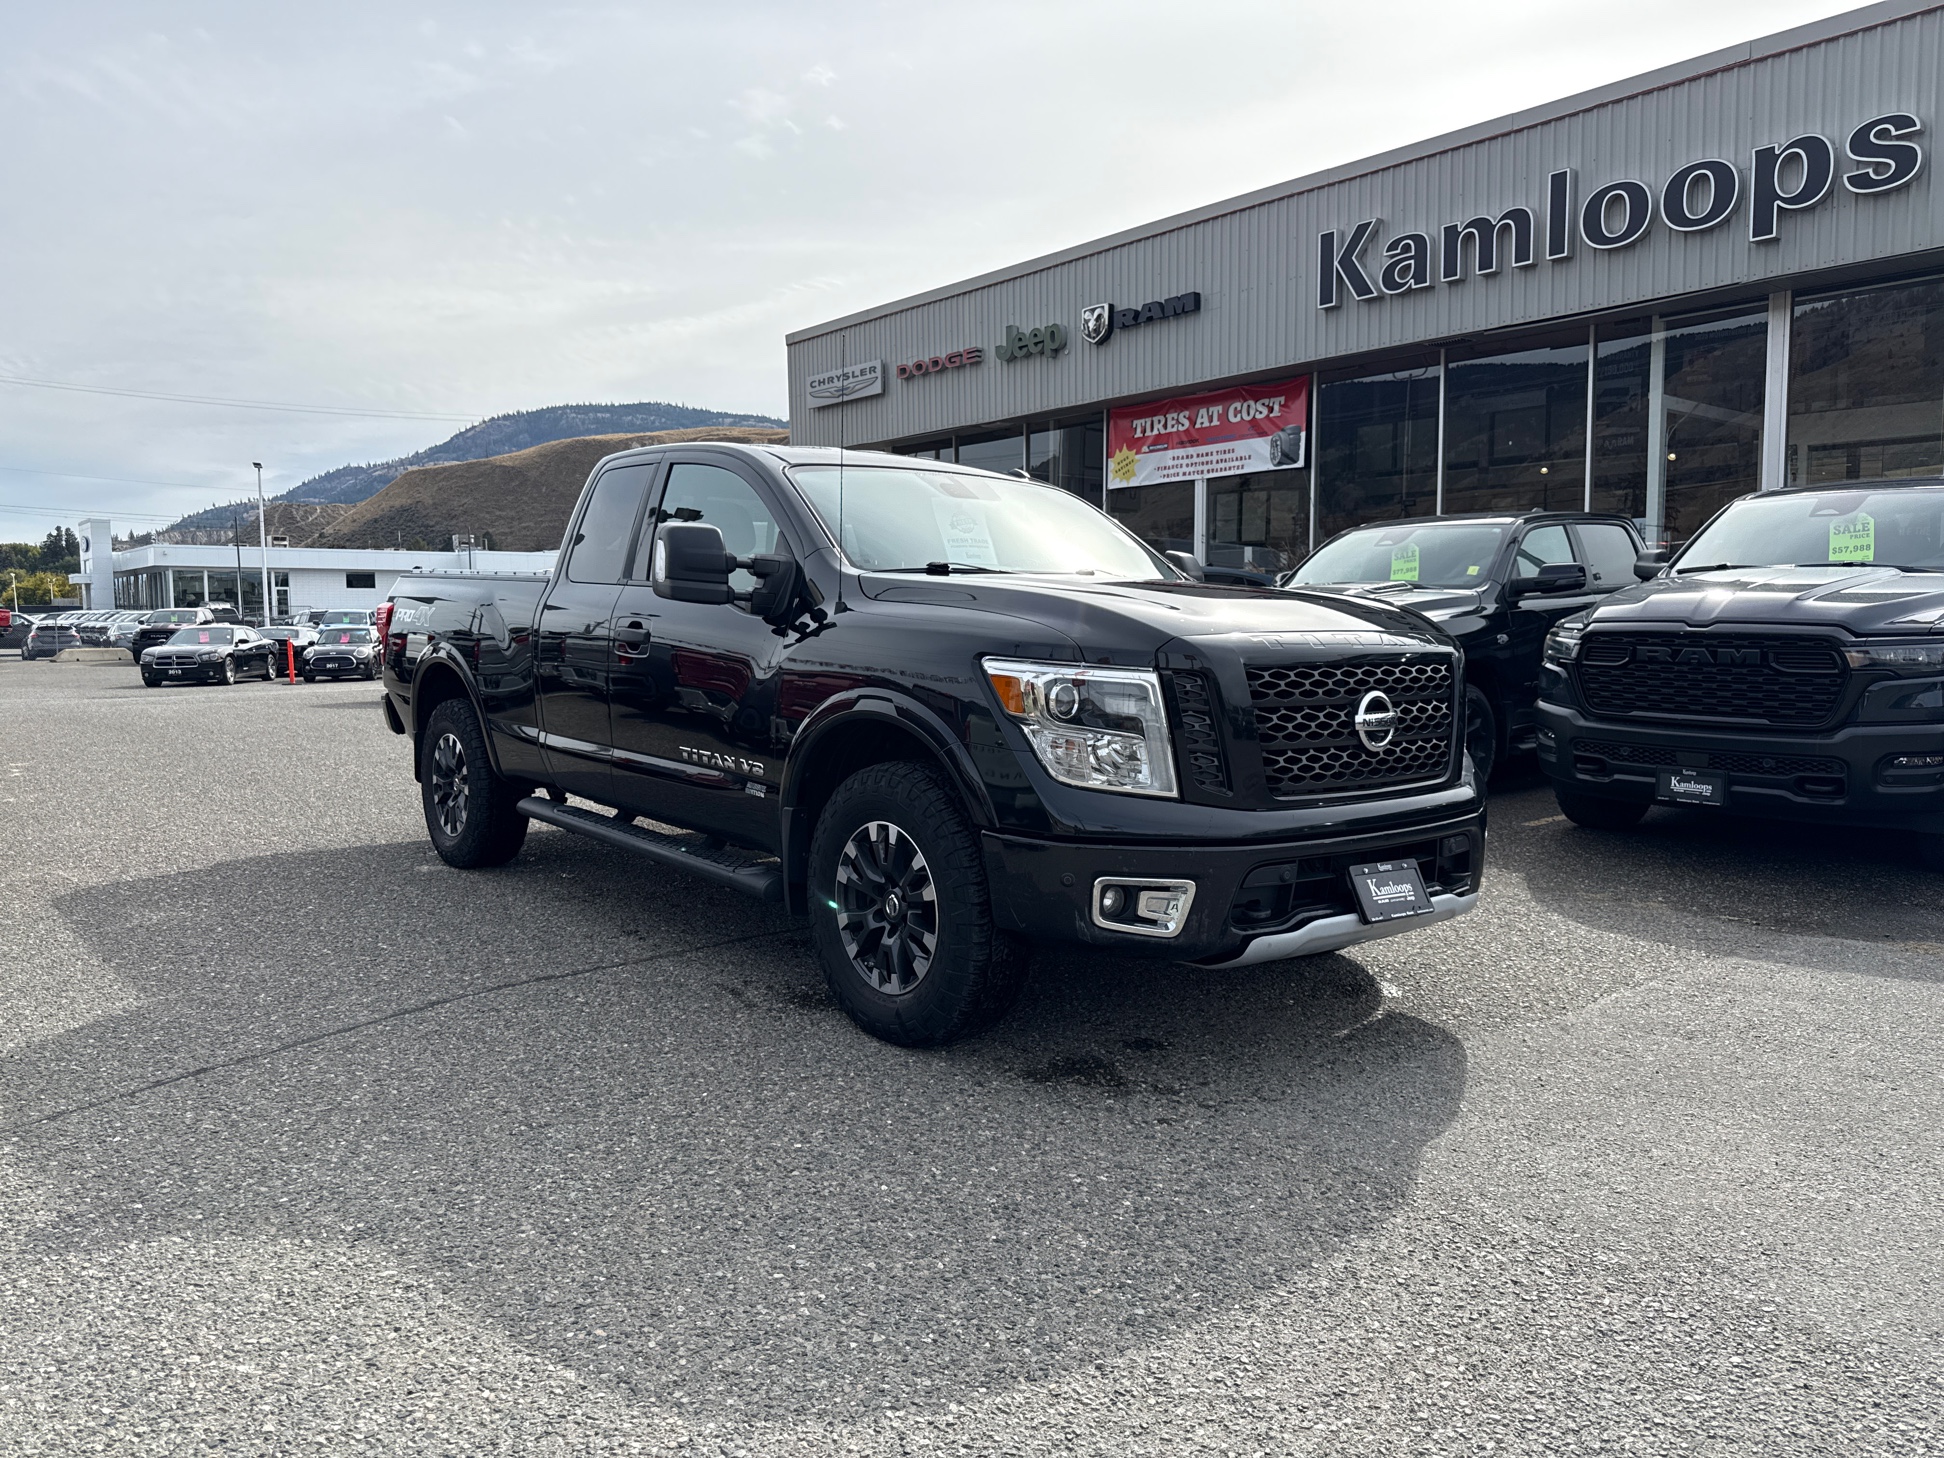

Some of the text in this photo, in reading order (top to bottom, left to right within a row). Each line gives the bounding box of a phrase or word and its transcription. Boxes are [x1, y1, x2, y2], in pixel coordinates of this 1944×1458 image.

[1316, 112, 1925, 309] Kamloops
[1114, 291, 1200, 329] RAM
[995, 323, 1067, 362] Jeep
[897, 346, 983, 379] DODGE
[809, 365, 877, 389] CHRYSLER
[1132, 396, 1285, 438] TIRES AT COST
[1215, 447, 1236, 456] TIRES
[1182, 469, 1205, 477] MATCH
[1206, 464, 1245, 475] GUARANTEE
[1185, 459, 1214, 469] OPTIONS
[1215, 454, 1252, 465] AVAILABLE
[1833, 522, 1871, 535] SALE
[1849, 532, 1871, 540] PRICE
[1394, 550, 1417, 561] SALE
[1831, 543, 1872, 555] $57,988
[1249, 633, 1440, 650] TITAN
[1636, 646, 1760, 665] RAM
[679, 746, 765, 777] TITAN V8
[1671, 776, 1713, 793] Kamloops
[1366, 879, 1413, 898] Kamloops
